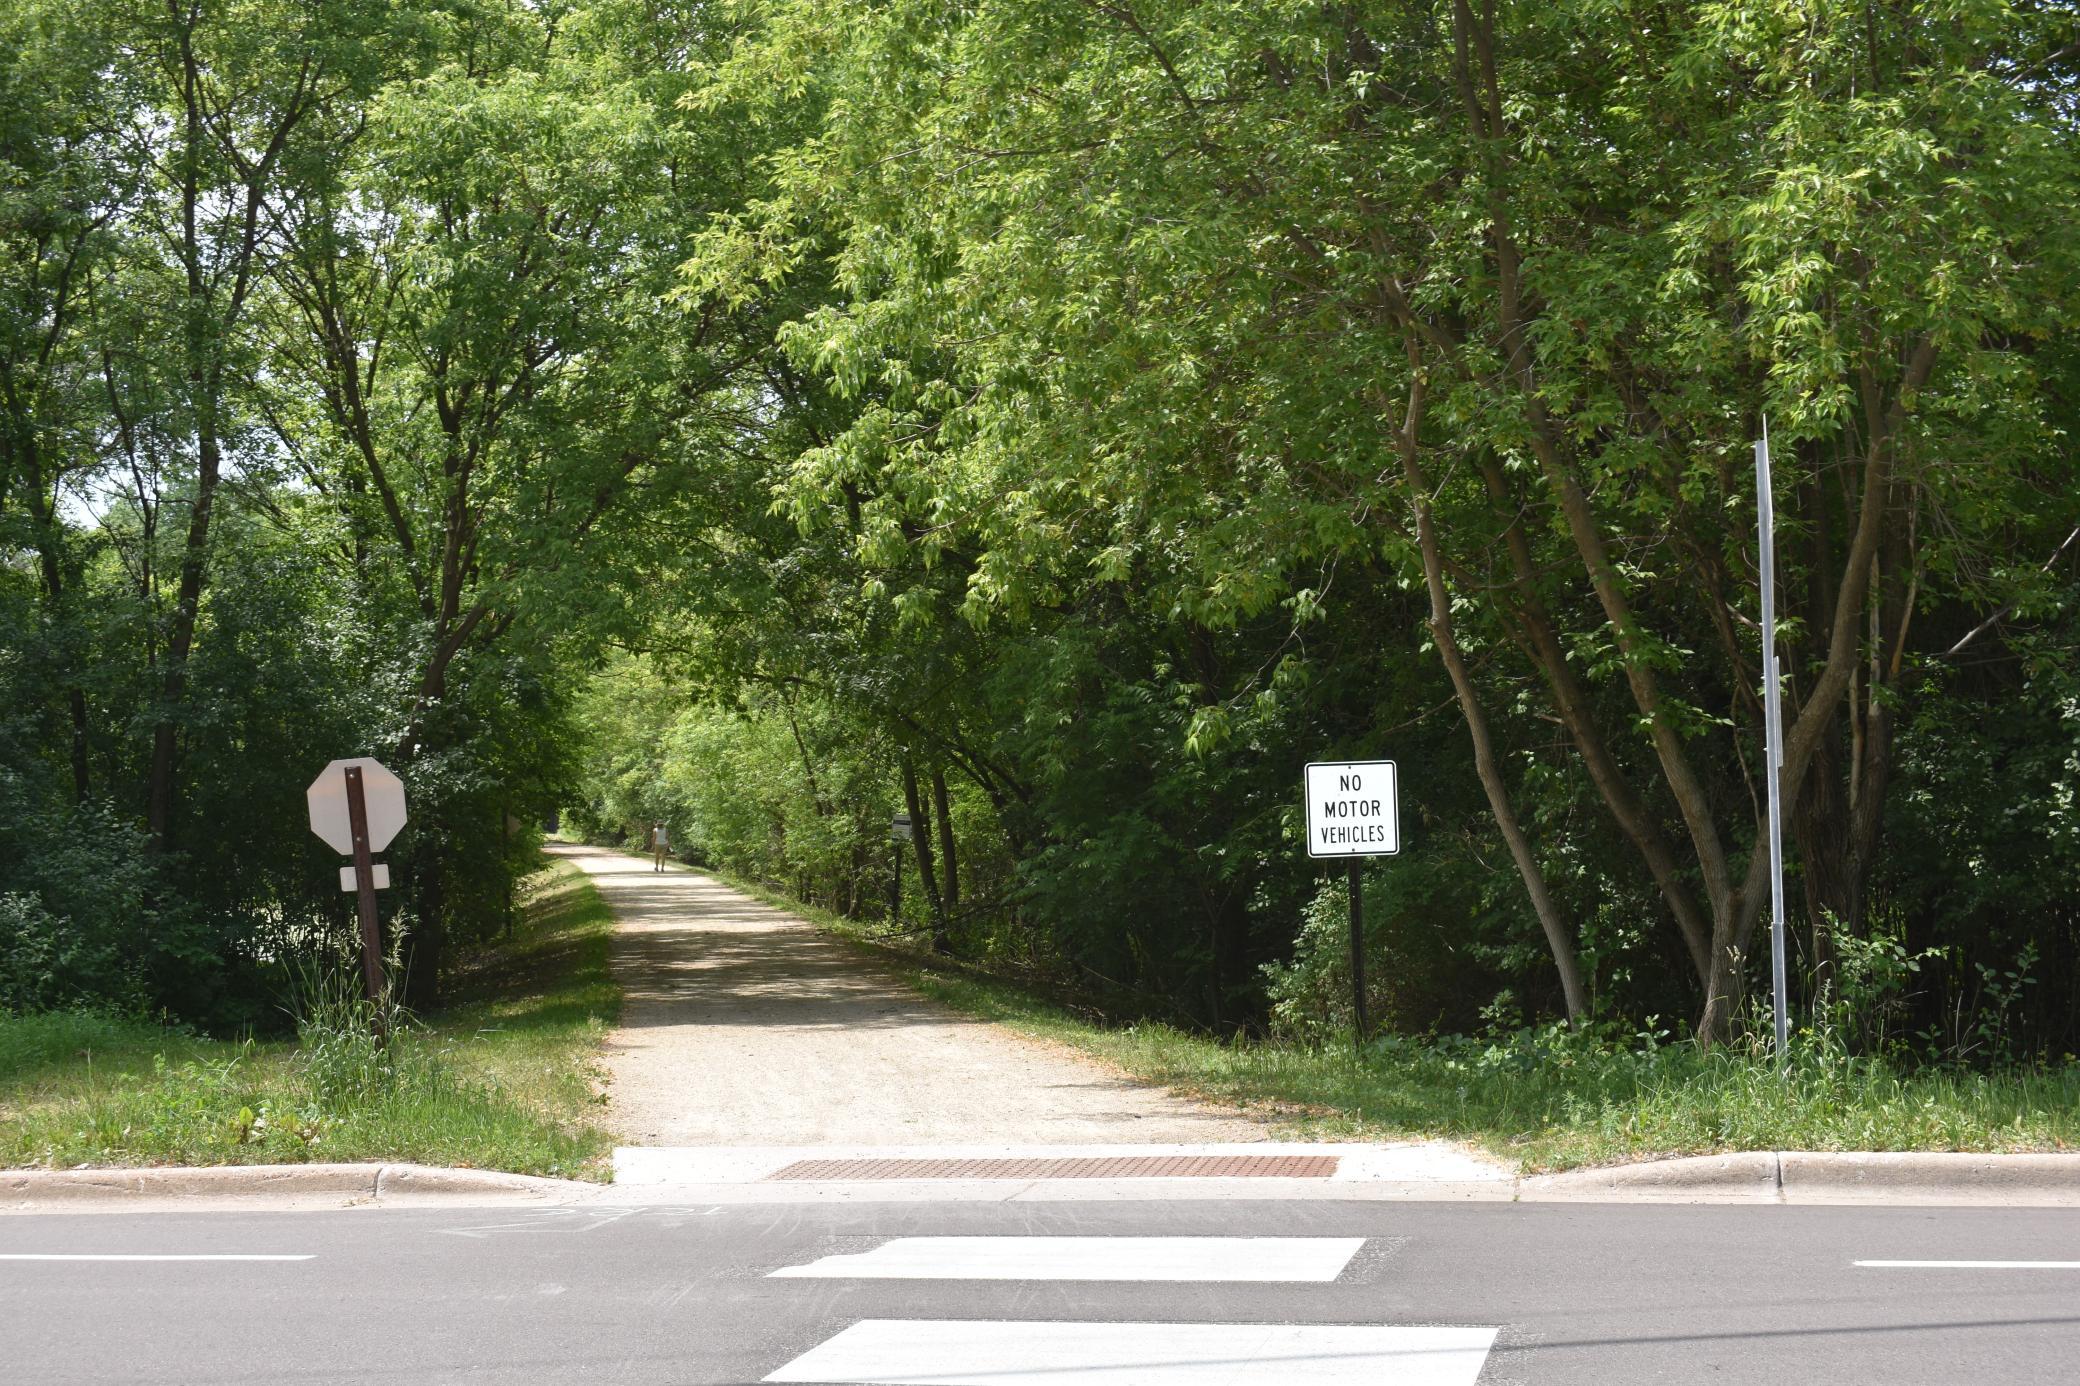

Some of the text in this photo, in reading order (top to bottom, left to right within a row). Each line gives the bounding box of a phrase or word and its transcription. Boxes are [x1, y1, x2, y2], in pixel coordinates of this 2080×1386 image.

[1340, 774, 1362, 792] NO
[1324, 800, 1381, 818] MOTOR
[1321, 825, 1385, 844] VEHICLES
